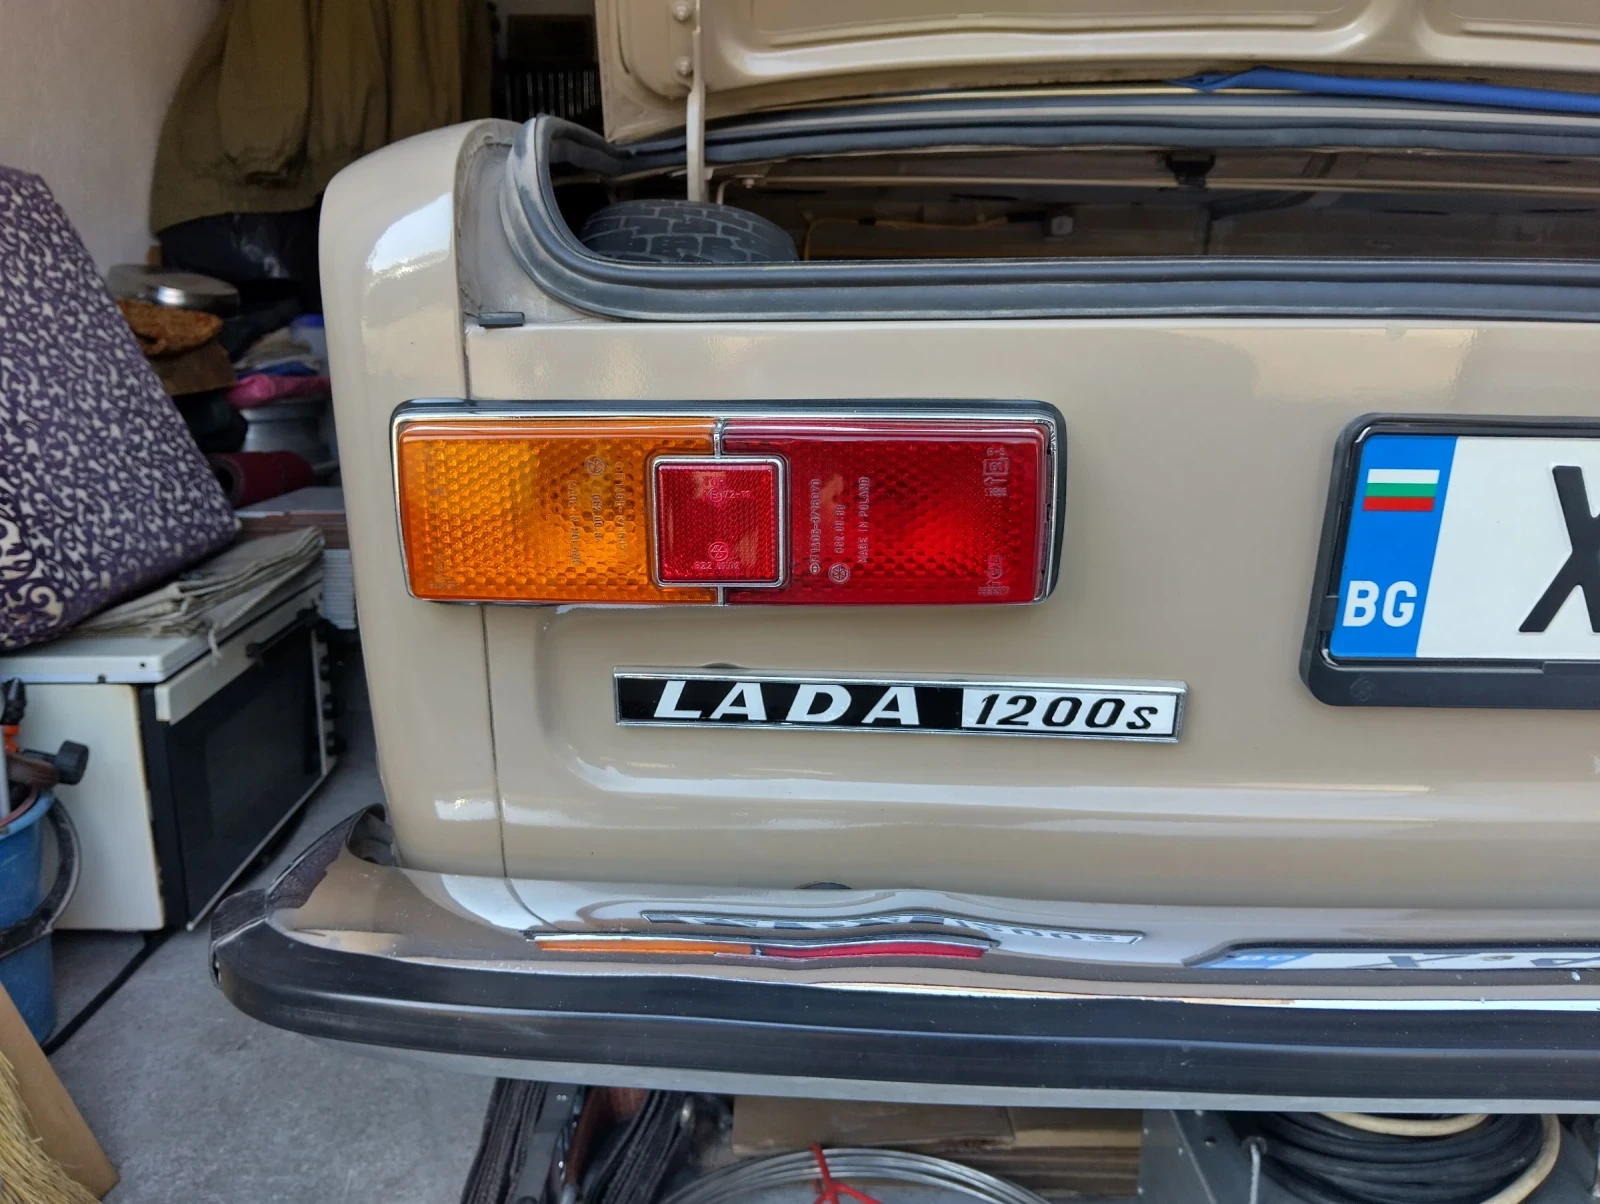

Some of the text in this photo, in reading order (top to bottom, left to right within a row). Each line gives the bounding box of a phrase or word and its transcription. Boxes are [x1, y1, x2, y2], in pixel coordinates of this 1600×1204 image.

[857, 477, 870, 564] MADE IN POLAND
[1342, 580, 1417, 627] BG
[652, 680, 921, 726] LADA
